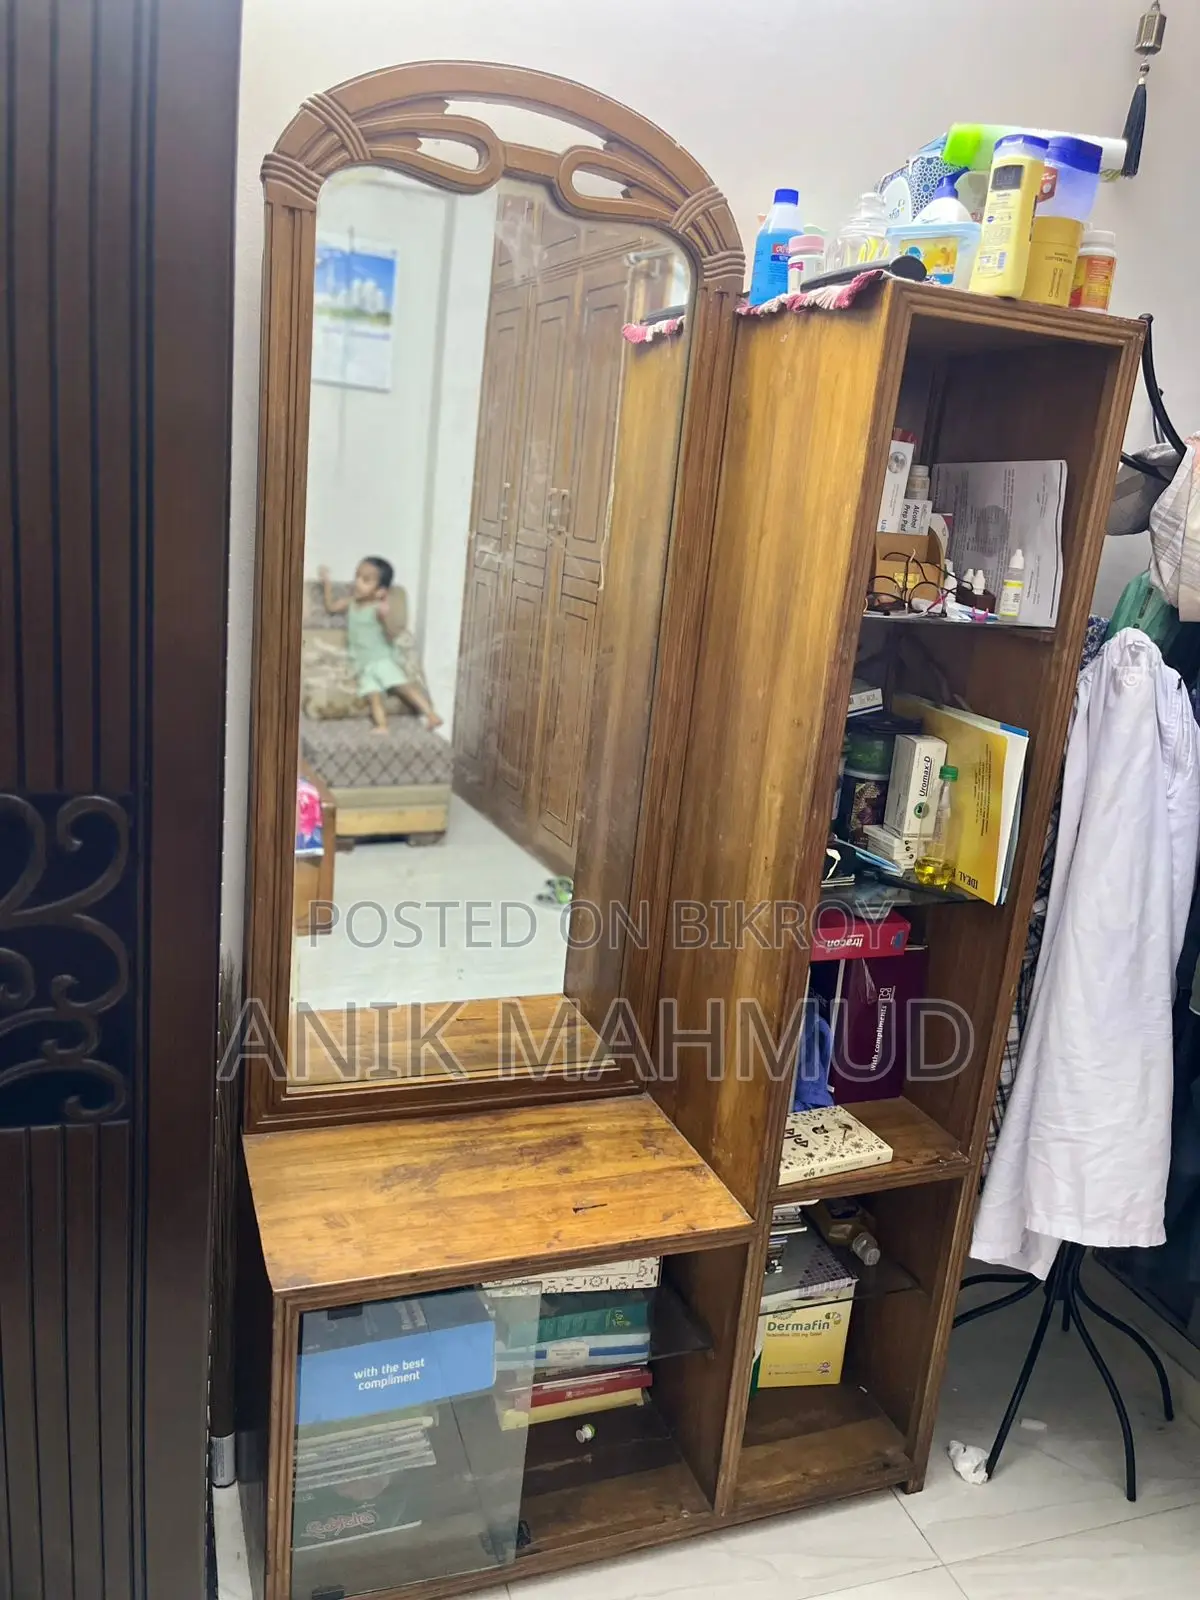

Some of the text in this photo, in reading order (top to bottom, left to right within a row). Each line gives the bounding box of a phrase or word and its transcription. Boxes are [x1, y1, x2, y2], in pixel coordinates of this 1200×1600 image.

[900, 504, 910, 532] Prep Pad
[911, 504, 920, 529] Alcohol
[919, 755, 931, 797] Uromax-D
[958, 870, 979, 890] IDEAL
[826, 937, 864, 948] Itracon
[874, 1004, 888, 1053] compliments
[767, 1319, 831, 1332] Dermafin
[353, 1357, 426, 1380] with the best
[358, 1370, 421, 1391] compliment
